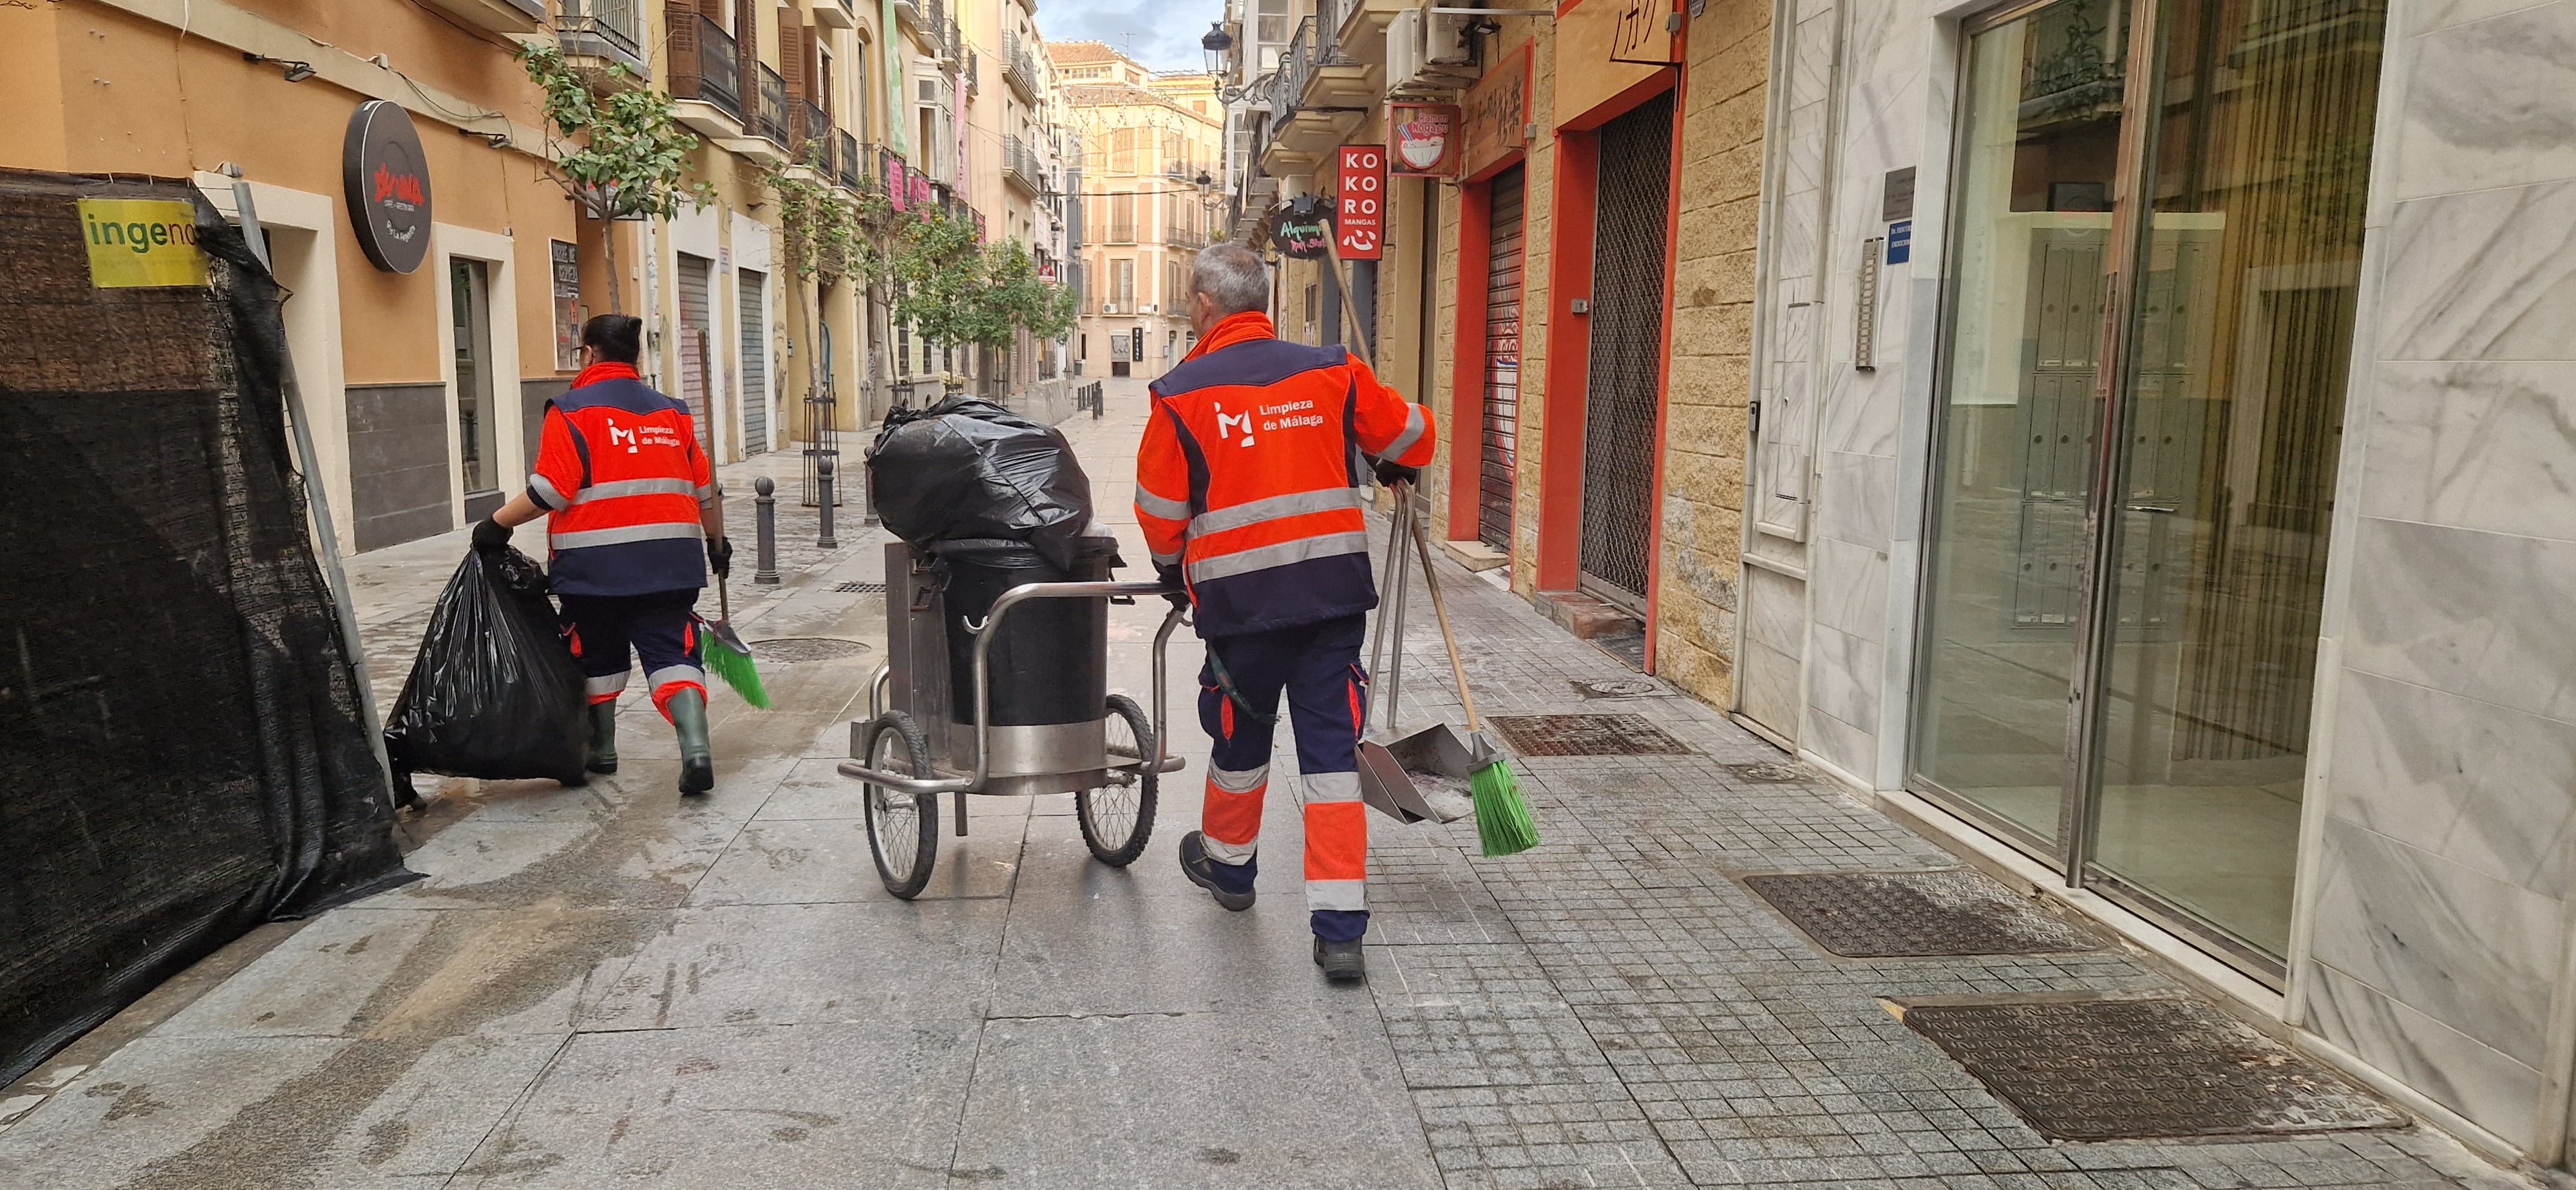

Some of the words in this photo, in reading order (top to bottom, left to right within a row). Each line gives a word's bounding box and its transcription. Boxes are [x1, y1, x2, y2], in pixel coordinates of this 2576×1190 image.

[1419, 113, 1448, 123] Ramen
[1259, 399, 1314, 415] Limpieza
[1264, 420, 1277, 431] de
[1280, 415, 1323, 430] Málaga
[638, 426, 674, 435] Limpieza
[654, 437, 680, 447] Málaga
